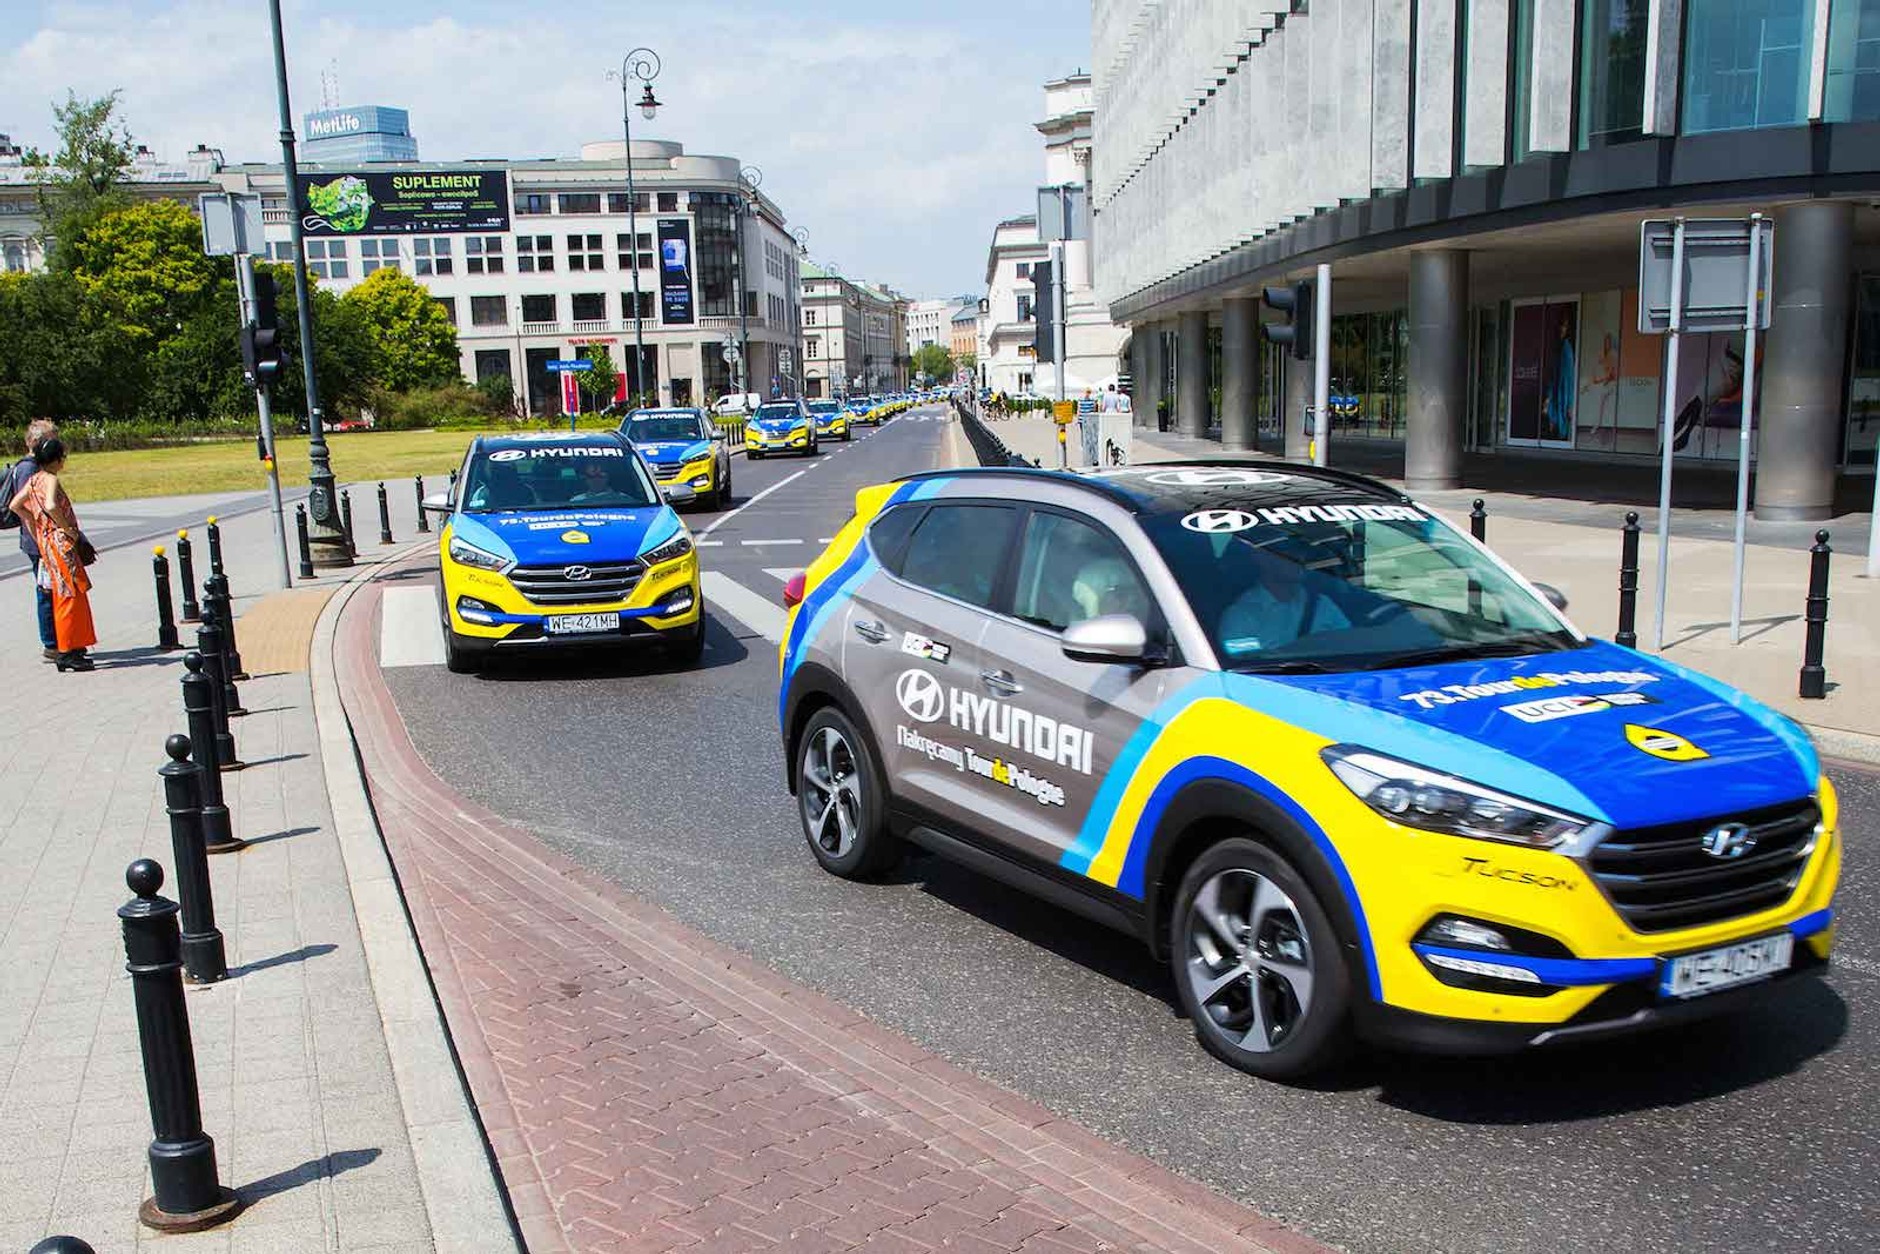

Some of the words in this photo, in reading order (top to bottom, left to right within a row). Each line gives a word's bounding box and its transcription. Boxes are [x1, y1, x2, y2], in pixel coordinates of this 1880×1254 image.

[311, 113, 360, 136] MetLife
[393, 175, 482, 189] SUPLEMENT
[530, 448, 624, 458] HYUNDAI
[1257, 505, 1428, 525] HYUNDAI
[576, 613, 618, 629] 421MH
[950, 687, 1094, 775] HYUNDAI
